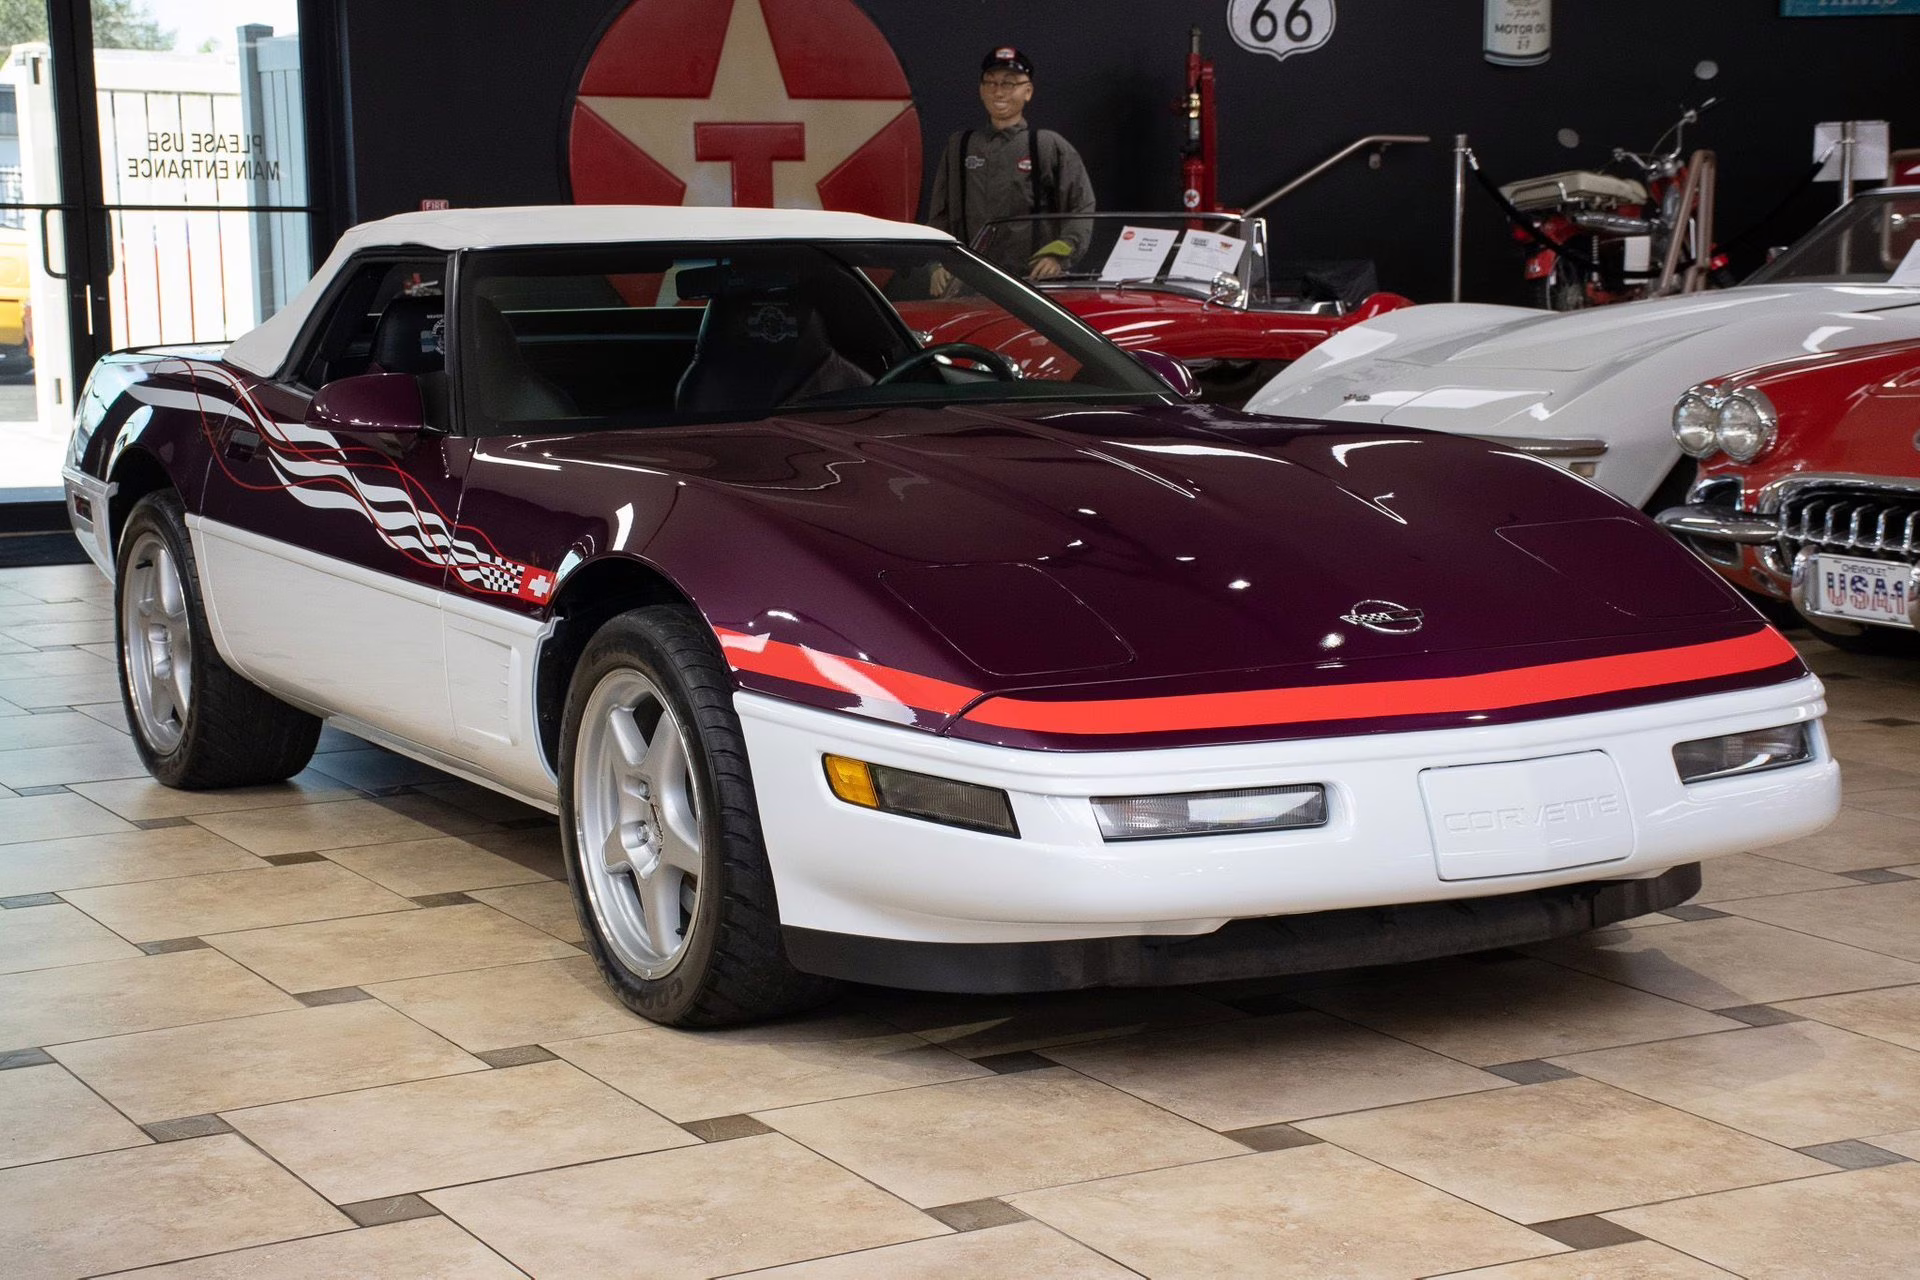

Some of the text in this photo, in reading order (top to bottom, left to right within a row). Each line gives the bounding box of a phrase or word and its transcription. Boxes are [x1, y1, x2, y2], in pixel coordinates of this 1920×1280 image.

[1250, 0, 1313, 43] 66
[1495, 23, 1533, 35] MOTOR
[695, 122, 806, 209] T
[1443, 793, 1621, 833] CORVETTE
